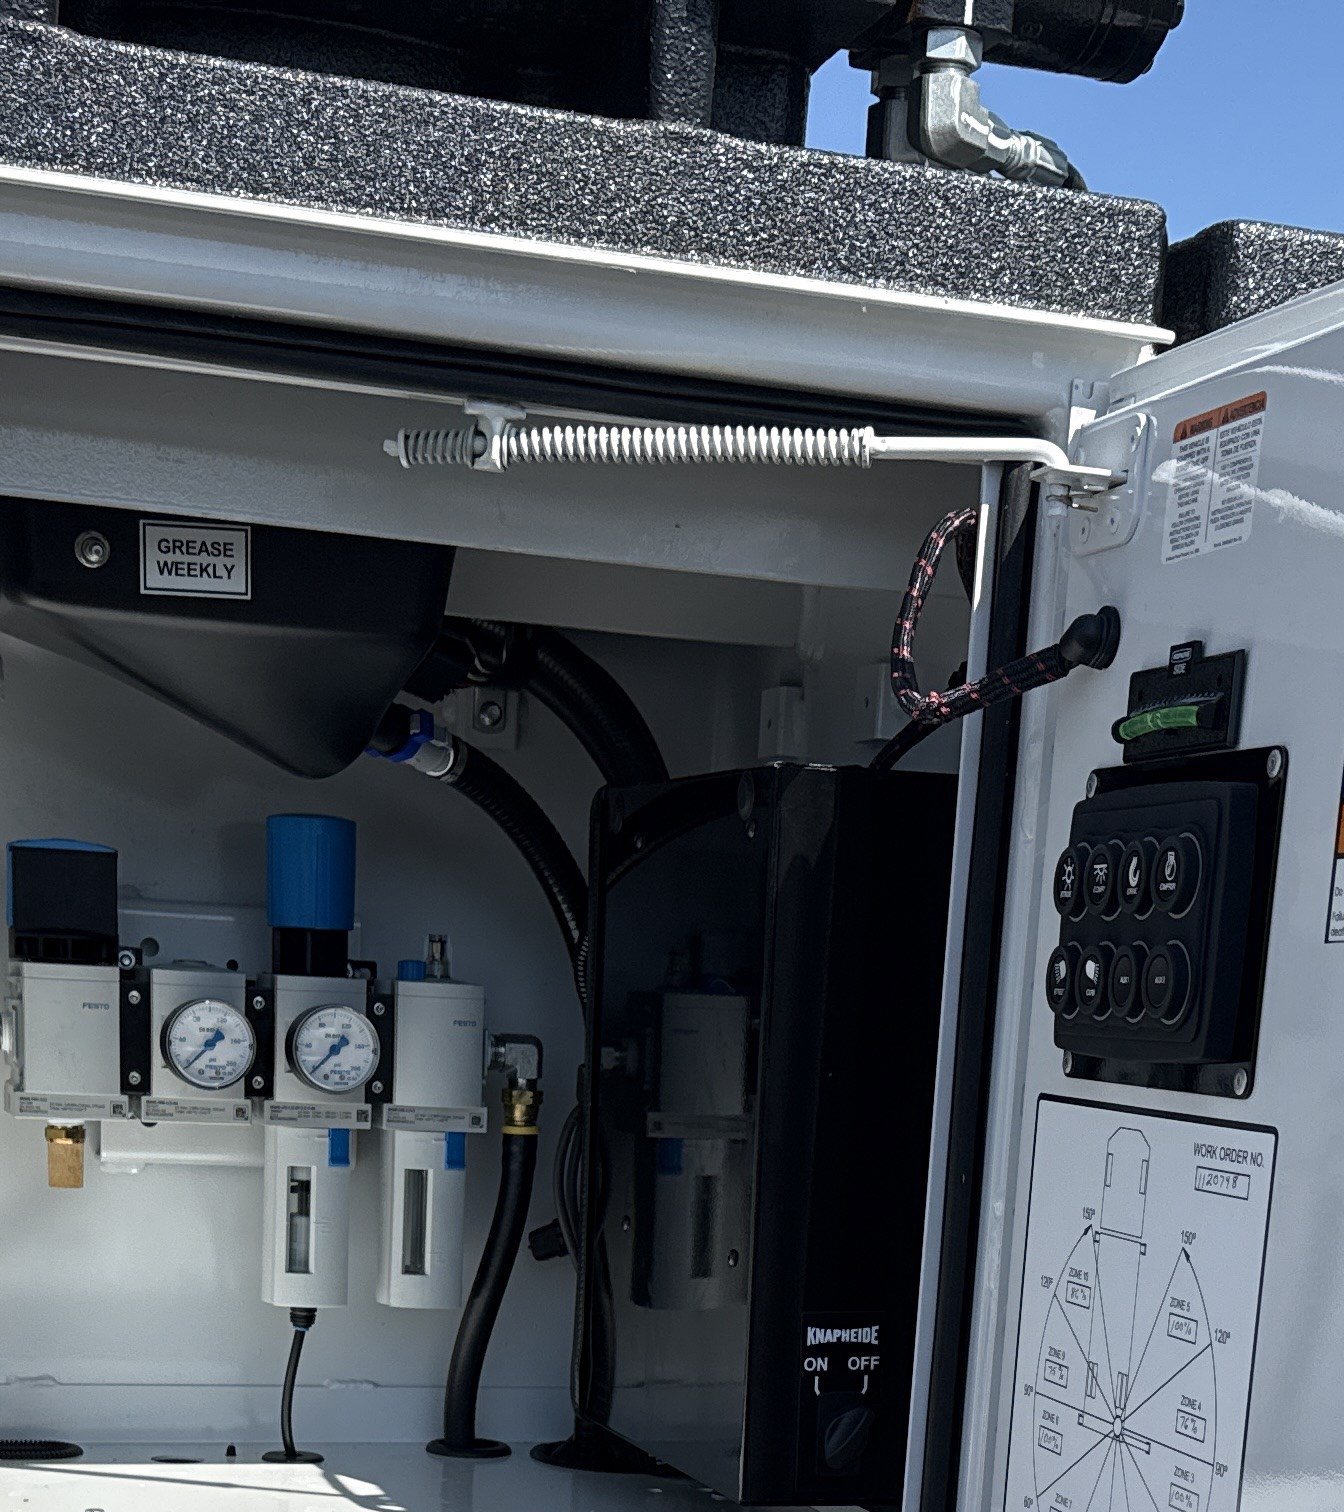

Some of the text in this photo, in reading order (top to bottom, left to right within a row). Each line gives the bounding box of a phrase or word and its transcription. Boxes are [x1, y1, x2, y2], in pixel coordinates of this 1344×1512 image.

[157, 538, 235, 558] GREASE
[157, 560, 235, 580] WEEKLY
[1334, 886, 1343, 897] Do
[82, 1002, 110, 1011] FESTO
[452, 1019, 477, 1028] FESTO
[1193, 1142, 1265, 1168] WORK ORDER NO.
[1069, 1266, 1082, 1280] ZONE
[1169, 1296, 1184, 1310] ZONE
[807, 1325, 880, 1347] KNAPHEIDE
[803, 1356, 880, 1372] ON OFF
[1181, 1395, 1196, 1409] ZONE
[1173, 1465, 1195, 1483] ZONE 3
[1054, 1493, 1068, 1507] ZONE
